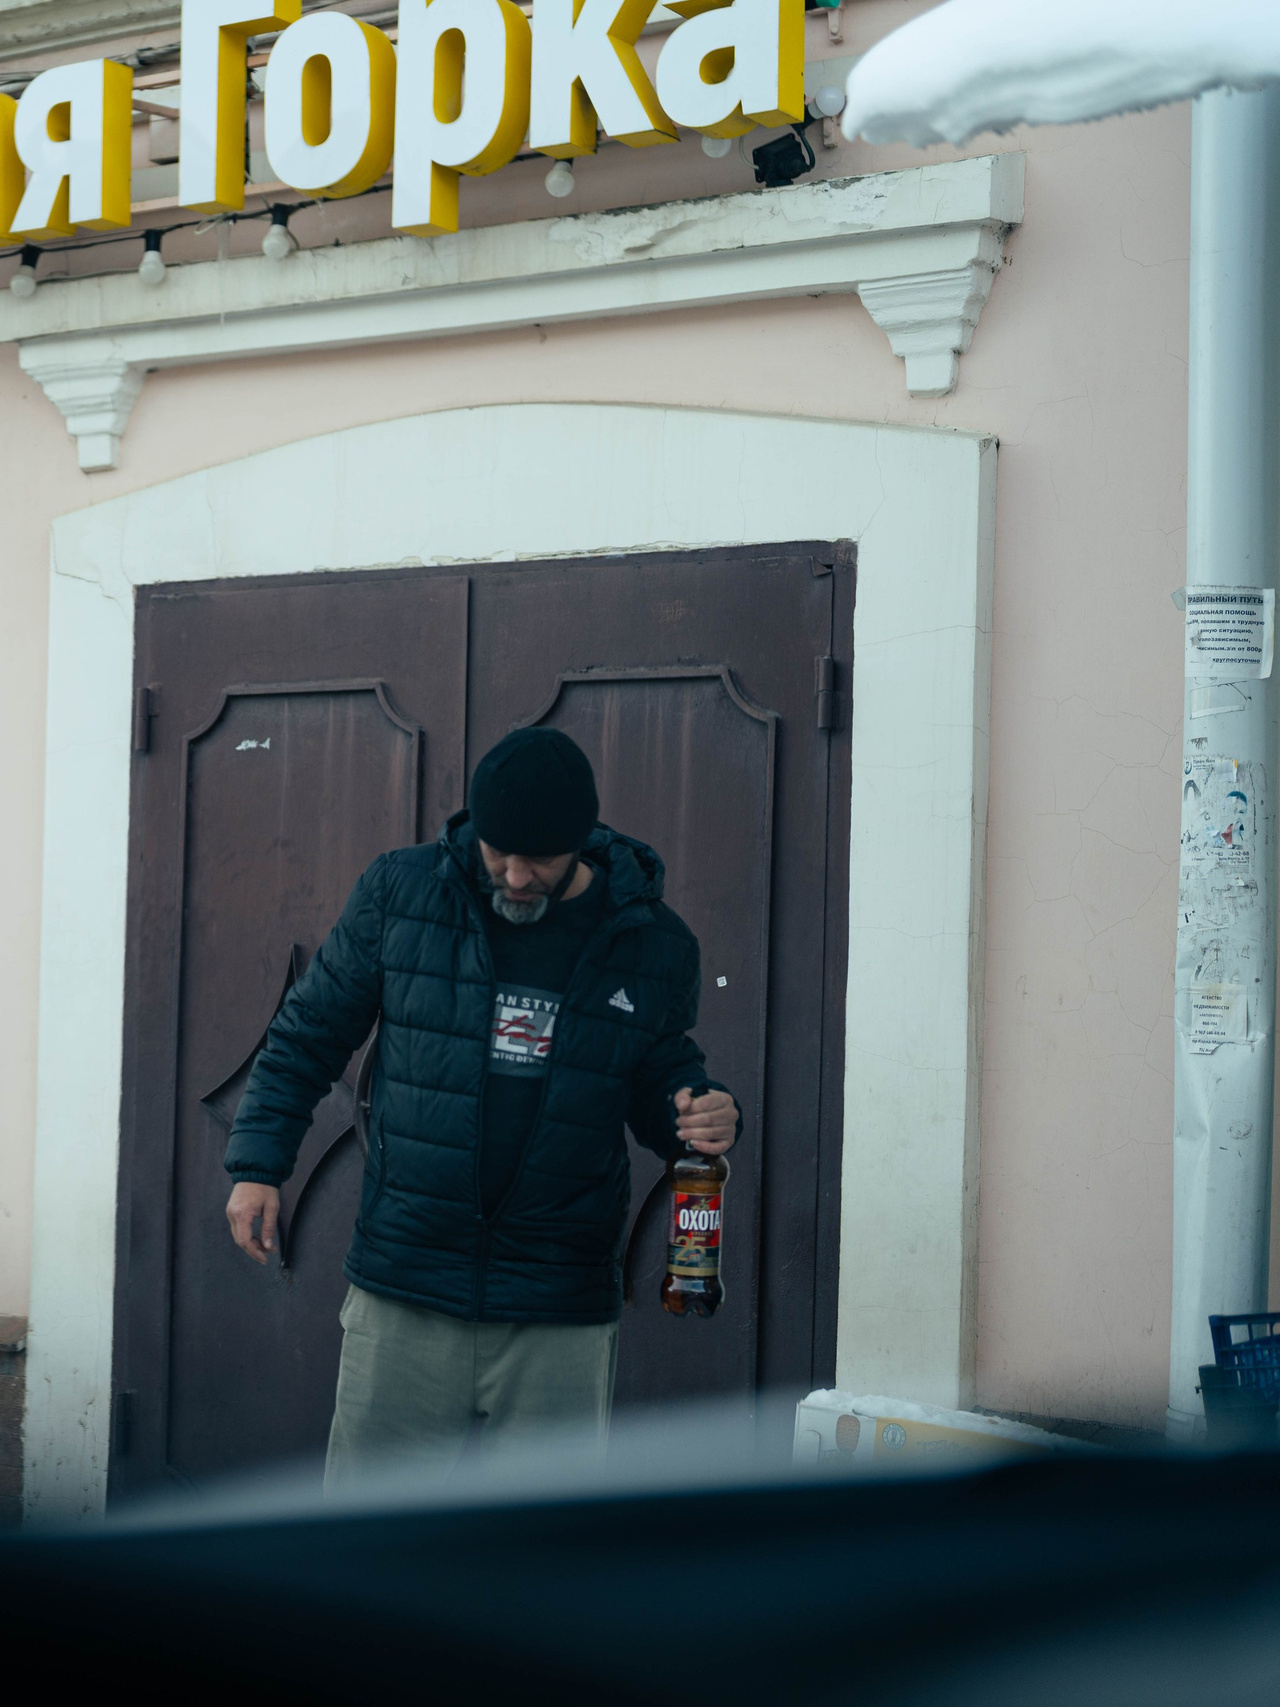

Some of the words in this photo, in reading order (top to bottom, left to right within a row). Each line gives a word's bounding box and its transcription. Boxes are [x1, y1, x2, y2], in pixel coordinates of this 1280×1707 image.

[178, 0, 805, 236] Горка
[495, 992, 518, 1006] AN
[678, 1208, 720, 1231] ОХОТА
